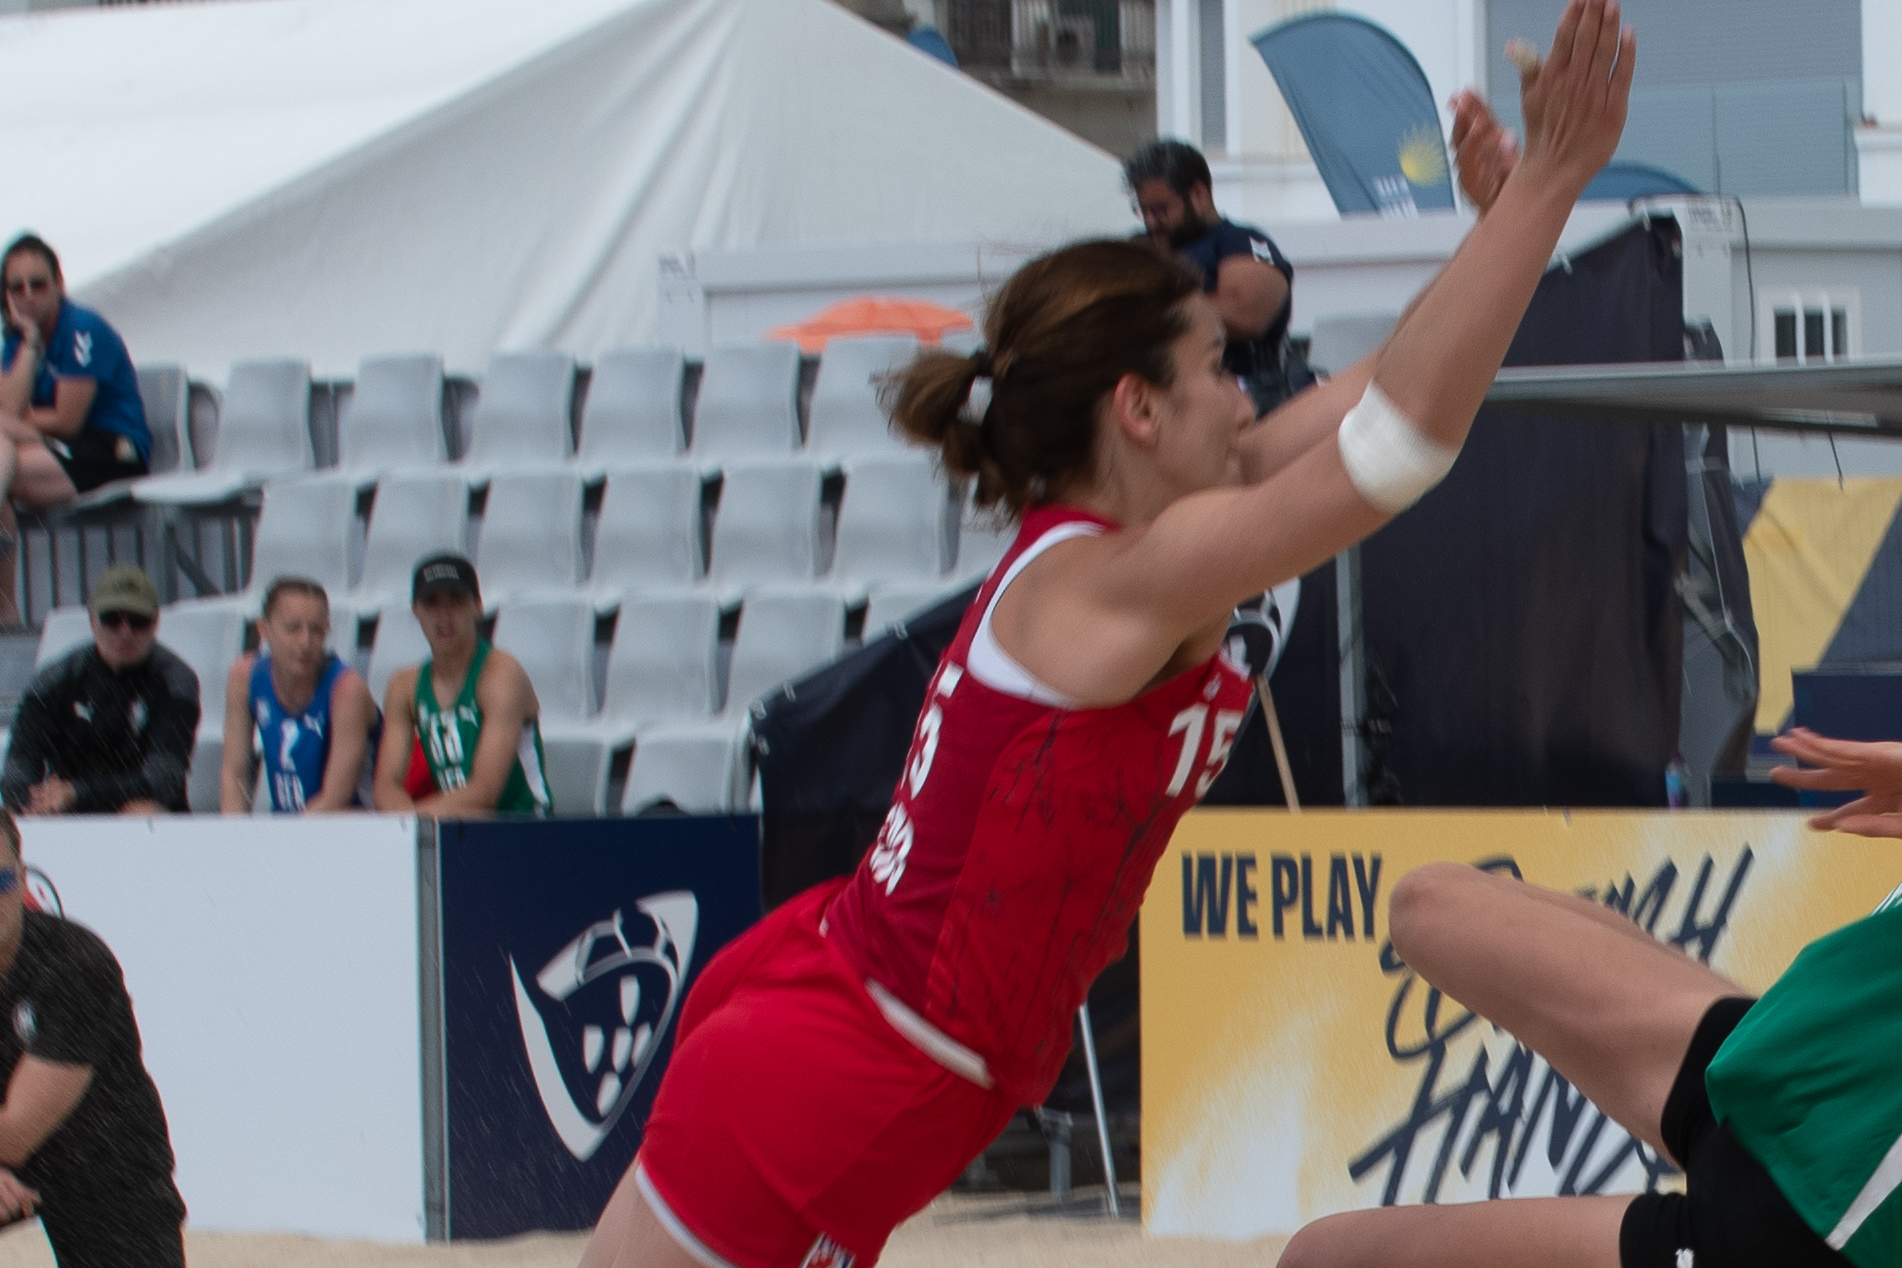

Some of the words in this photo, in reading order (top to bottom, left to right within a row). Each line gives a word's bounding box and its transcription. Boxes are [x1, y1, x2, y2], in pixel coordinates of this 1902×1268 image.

[1164, 701, 1247, 799] 15
[1180, 850, 1258, 941] WE
[1271, 850, 1383, 941] PLAY
